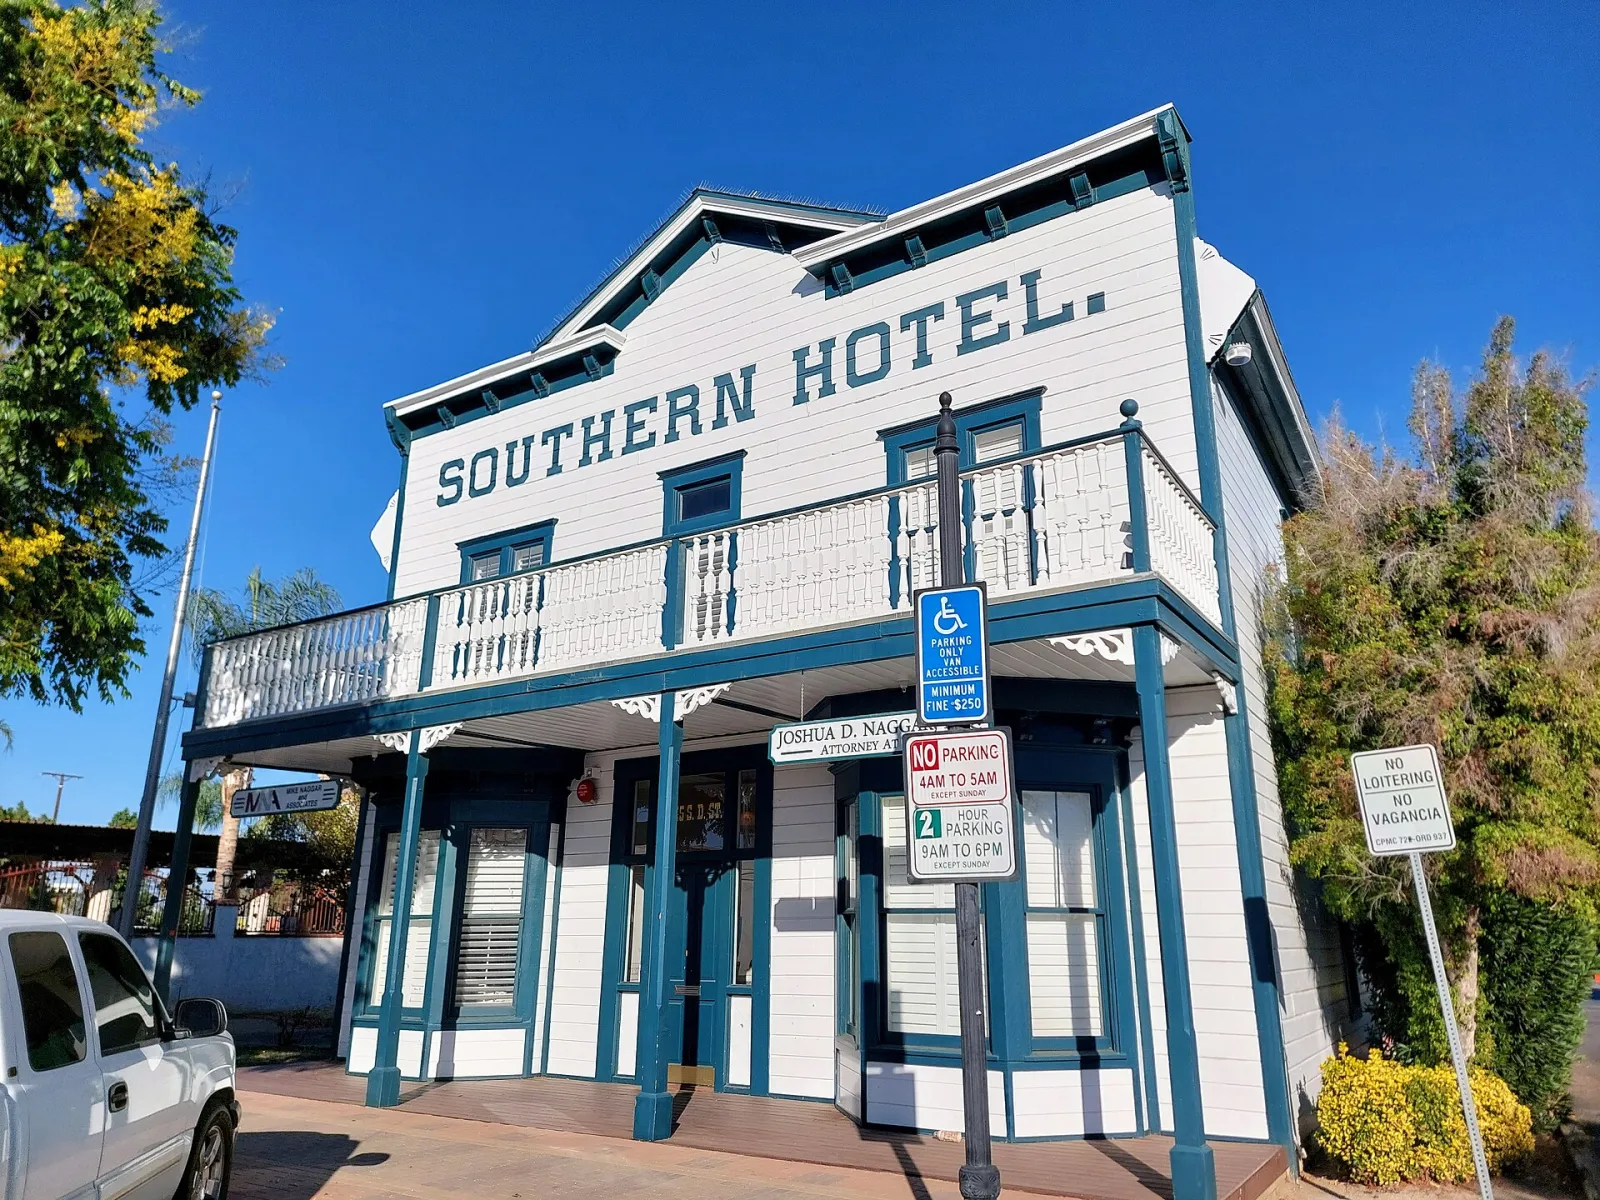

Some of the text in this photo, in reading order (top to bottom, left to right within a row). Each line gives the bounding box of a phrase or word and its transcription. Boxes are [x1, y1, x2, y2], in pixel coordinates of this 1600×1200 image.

[437, 269, 1106, 507] SOUTHERN HOTEL.
[931, 636, 972, 648] PARKING
[939, 647, 964, 658] ONLY
[943, 658, 962, 667] VAN
[926, 665, 980, 678] ACCESSIBLE
[931, 684, 975, 697] MINIMUM
[926, 700, 949, 712] FINE
[776, 718, 937, 749] JOSHUA D. NAGGA
[820, 738, 898, 756] ATTORNEY AT
[913, 743, 999, 768] NO PARKING
[1385, 757, 1404, 771] NO
[920, 771, 998, 789] 4AM TO 5AM
[1363, 770, 1434, 790] LOITERING
[286, 787, 299, 795] MIKE
[931, 789, 987, 799] EXCEPT SUNDAY
[286, 799, 318, 810] ASSOCIATES
[1393, 793, 1412, 807] NO
[958, 809, 989, 821] HOUR
[1372, 807, 1442, 826] VAGANCIA
[920, 811, 934, 838] 2
[946, 821, 1003, 837] PARKING
[1375, 836, 1397, 846] CPMC
[1433, 832, 1447, 841] 937
[922, 842, 1003, 859] 9AM TO 6PM
[934, 860, 991, 869] EXCEPT SUNDAY
